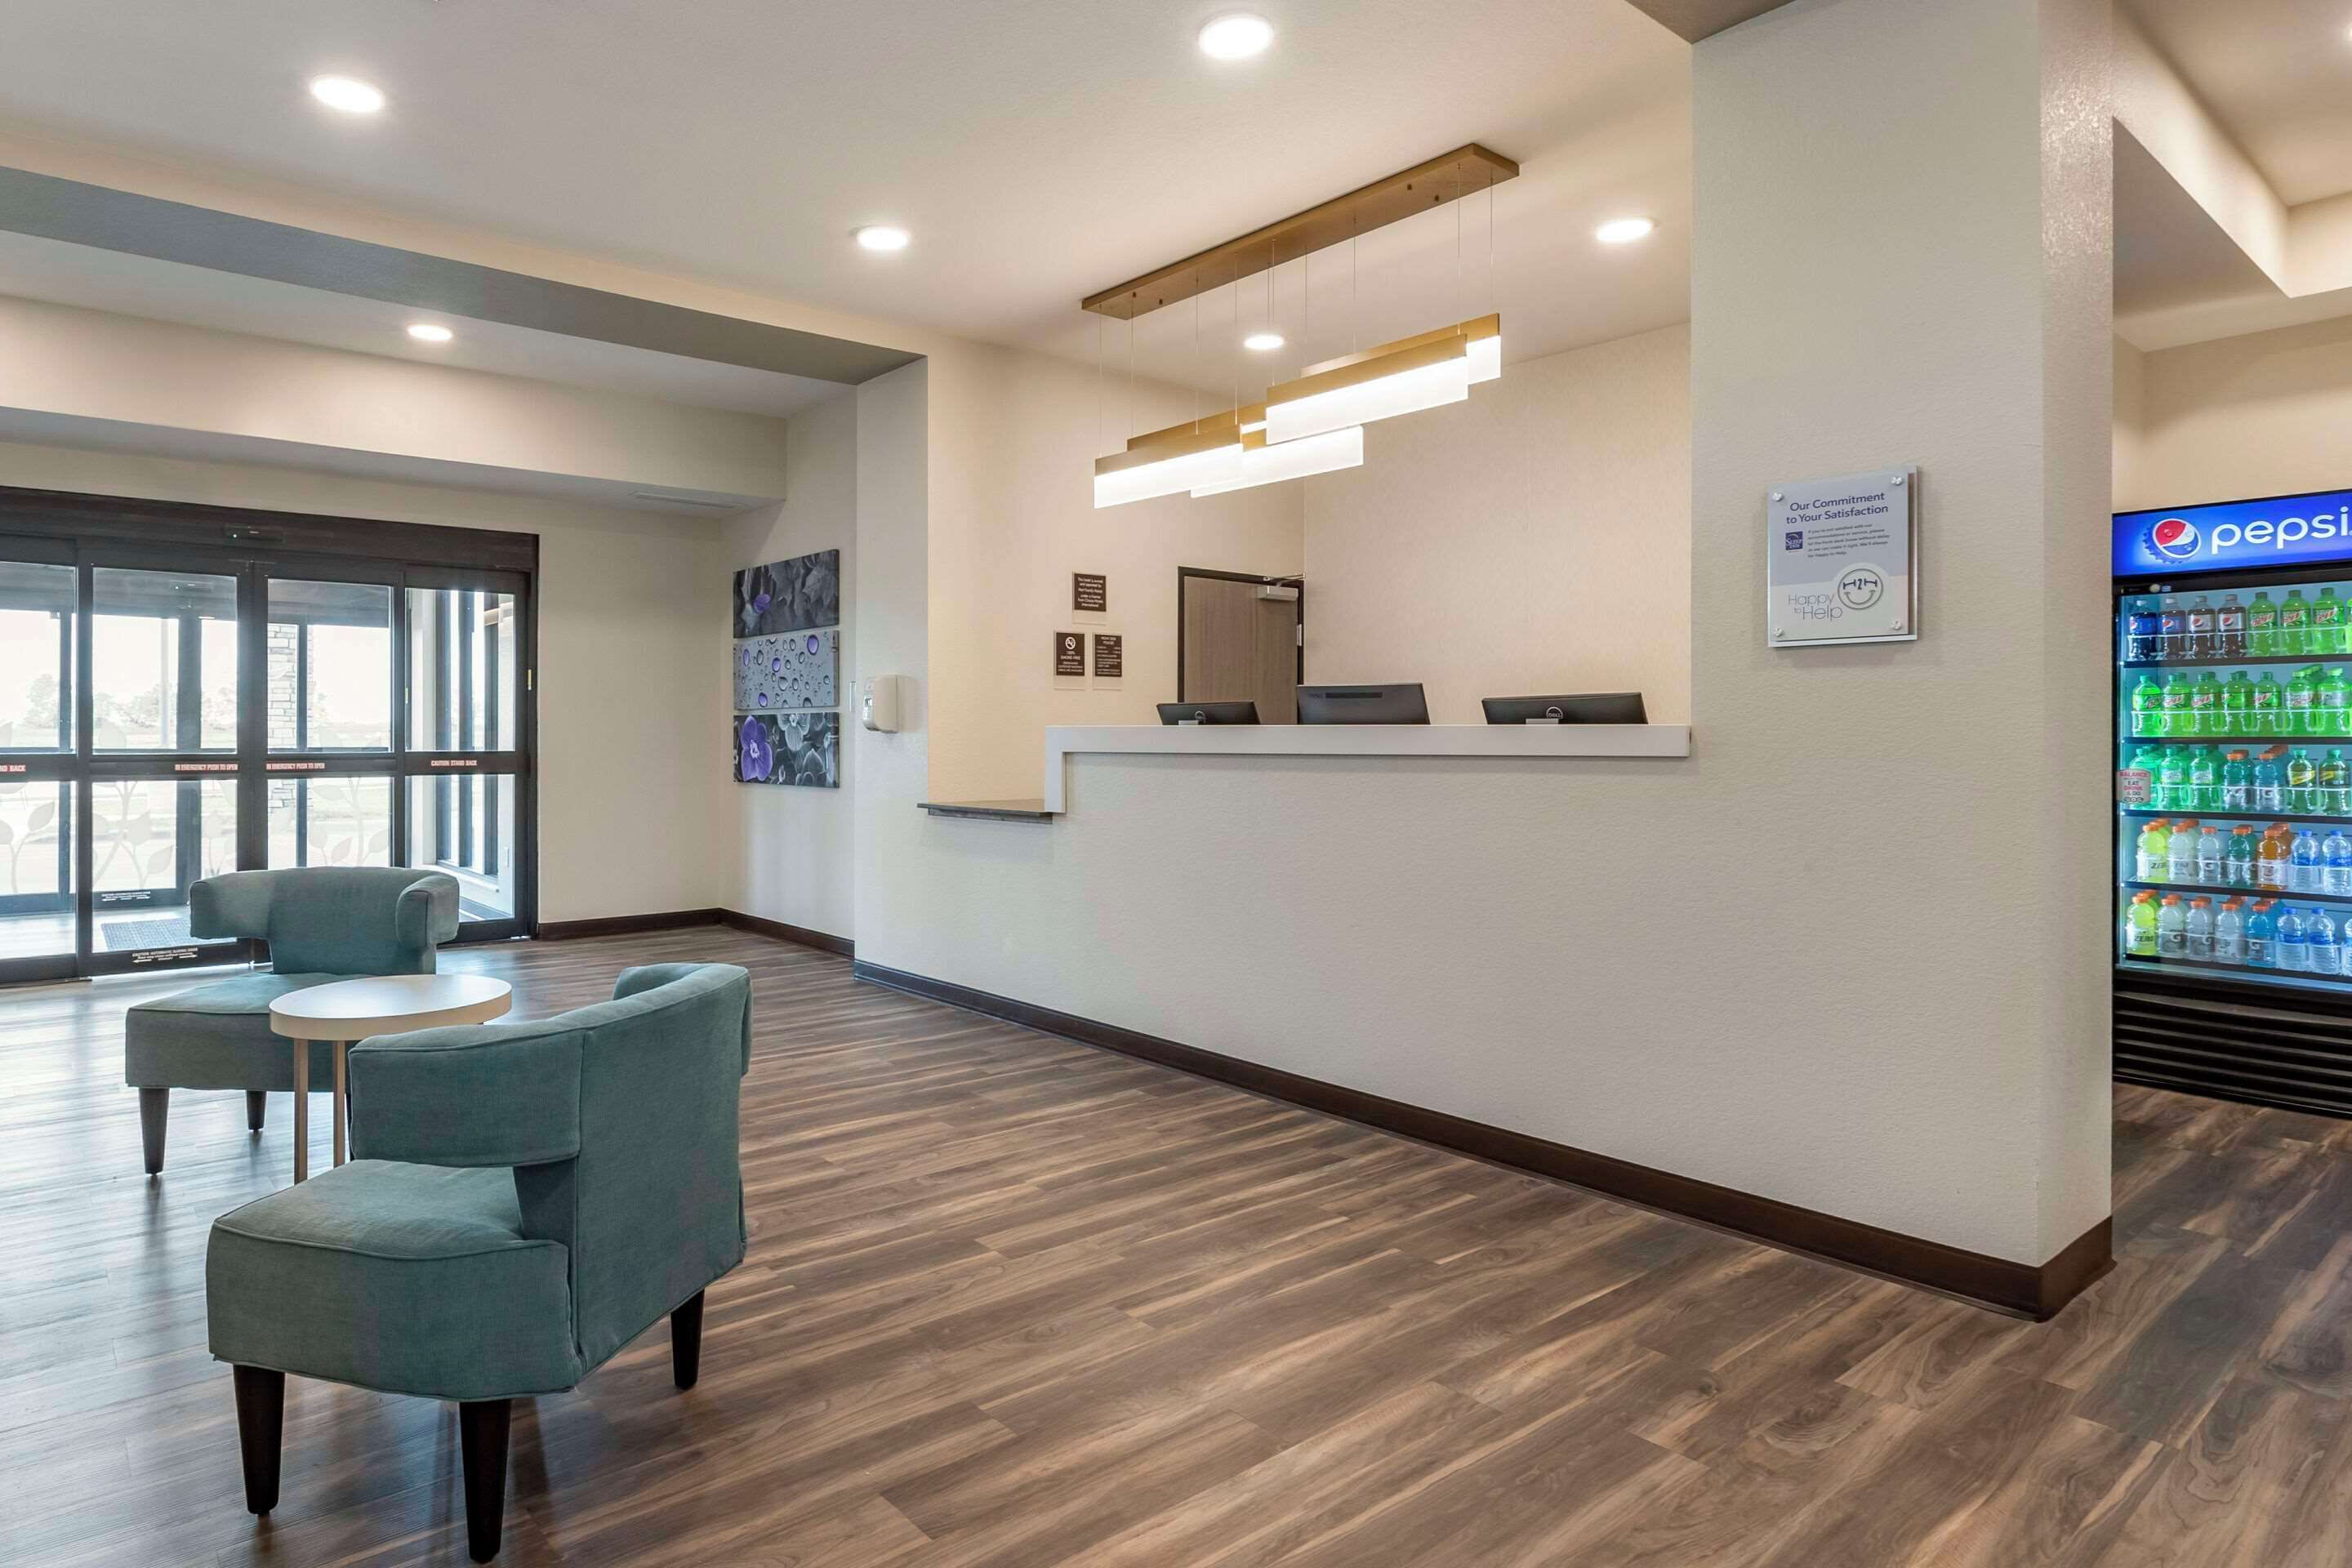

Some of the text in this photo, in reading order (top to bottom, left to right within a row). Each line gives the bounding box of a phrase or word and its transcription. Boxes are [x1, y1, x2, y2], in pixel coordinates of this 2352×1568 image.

[1789, 492, 1885, 511] Our Commitment
[1786, 505, 1889, 524] to Your Satisfaction
[2211, 506, 2349, 555] pepsi
[1788, 594, 1835, 606] Happy
[1802, 605, 1843, 621] Help
